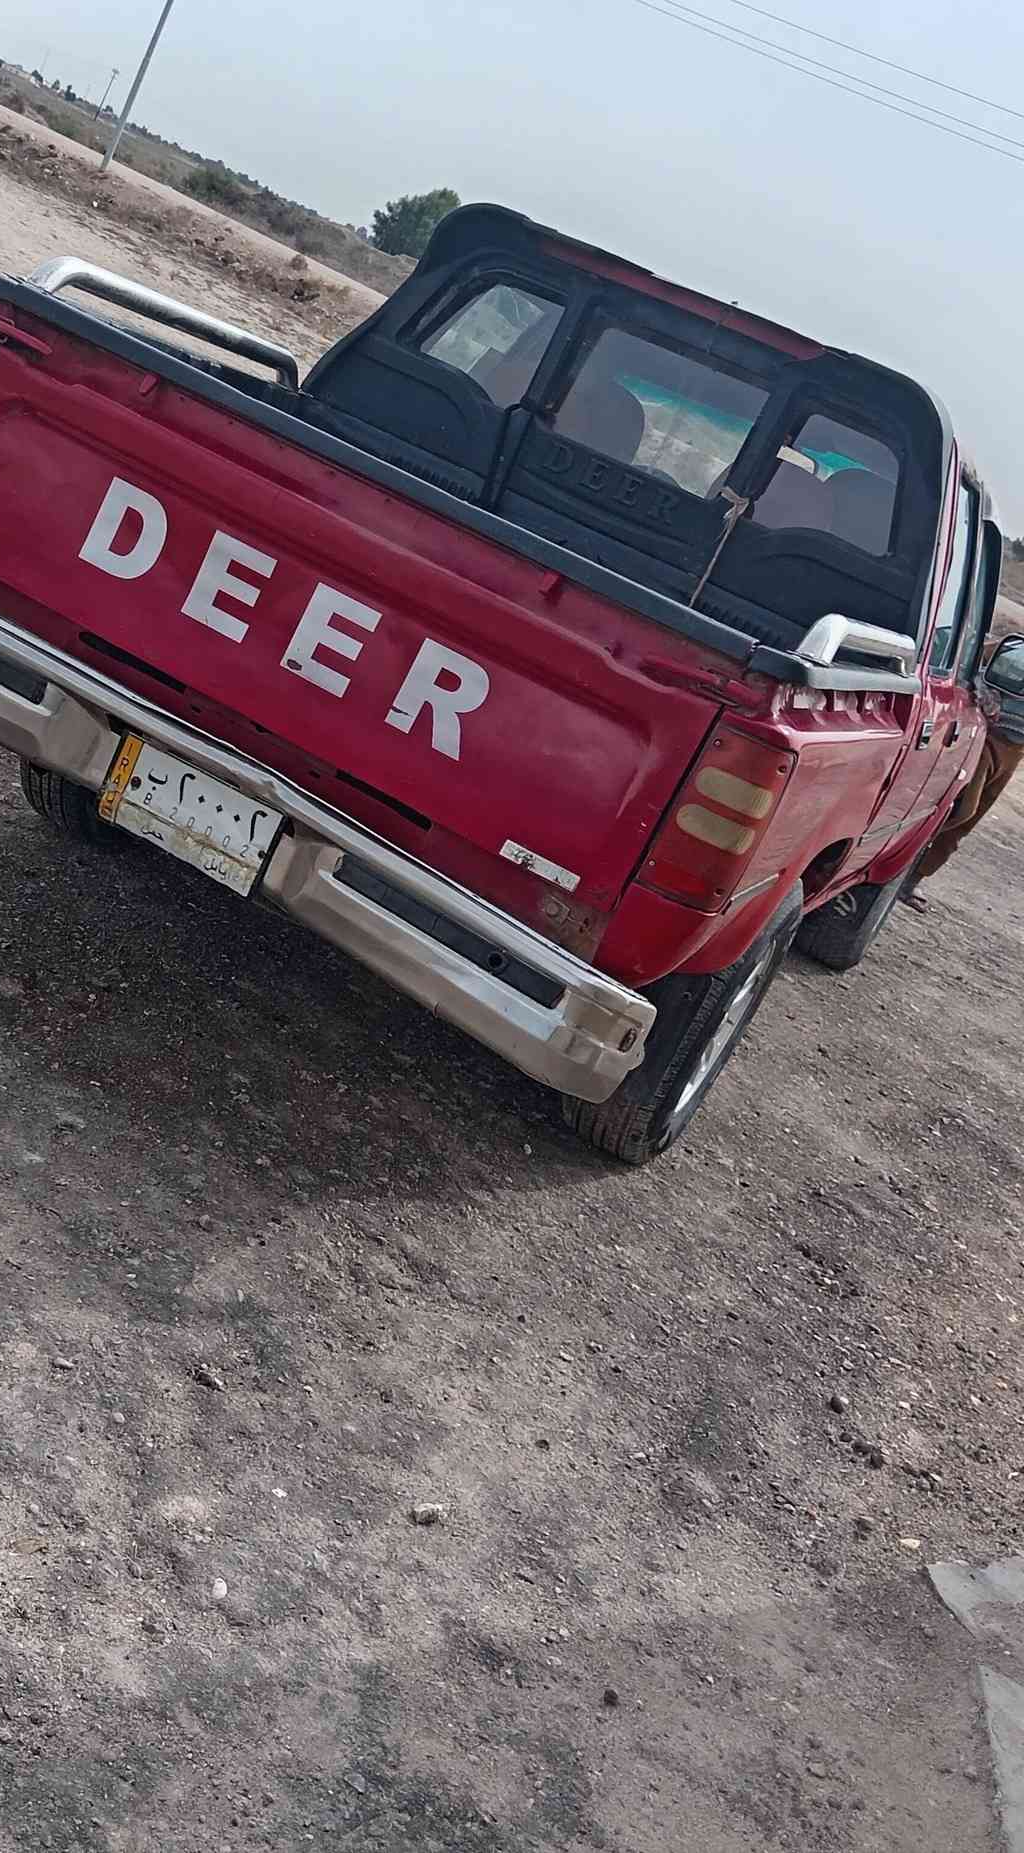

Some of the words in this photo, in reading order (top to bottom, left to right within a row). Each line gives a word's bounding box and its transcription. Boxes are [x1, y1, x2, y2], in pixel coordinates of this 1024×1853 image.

[541, 442, 680, 527] DEER
[78, 476, 490, 761] DEER
[143, 792, 153, 805] B
[168, 807, 249, 858] 20002
